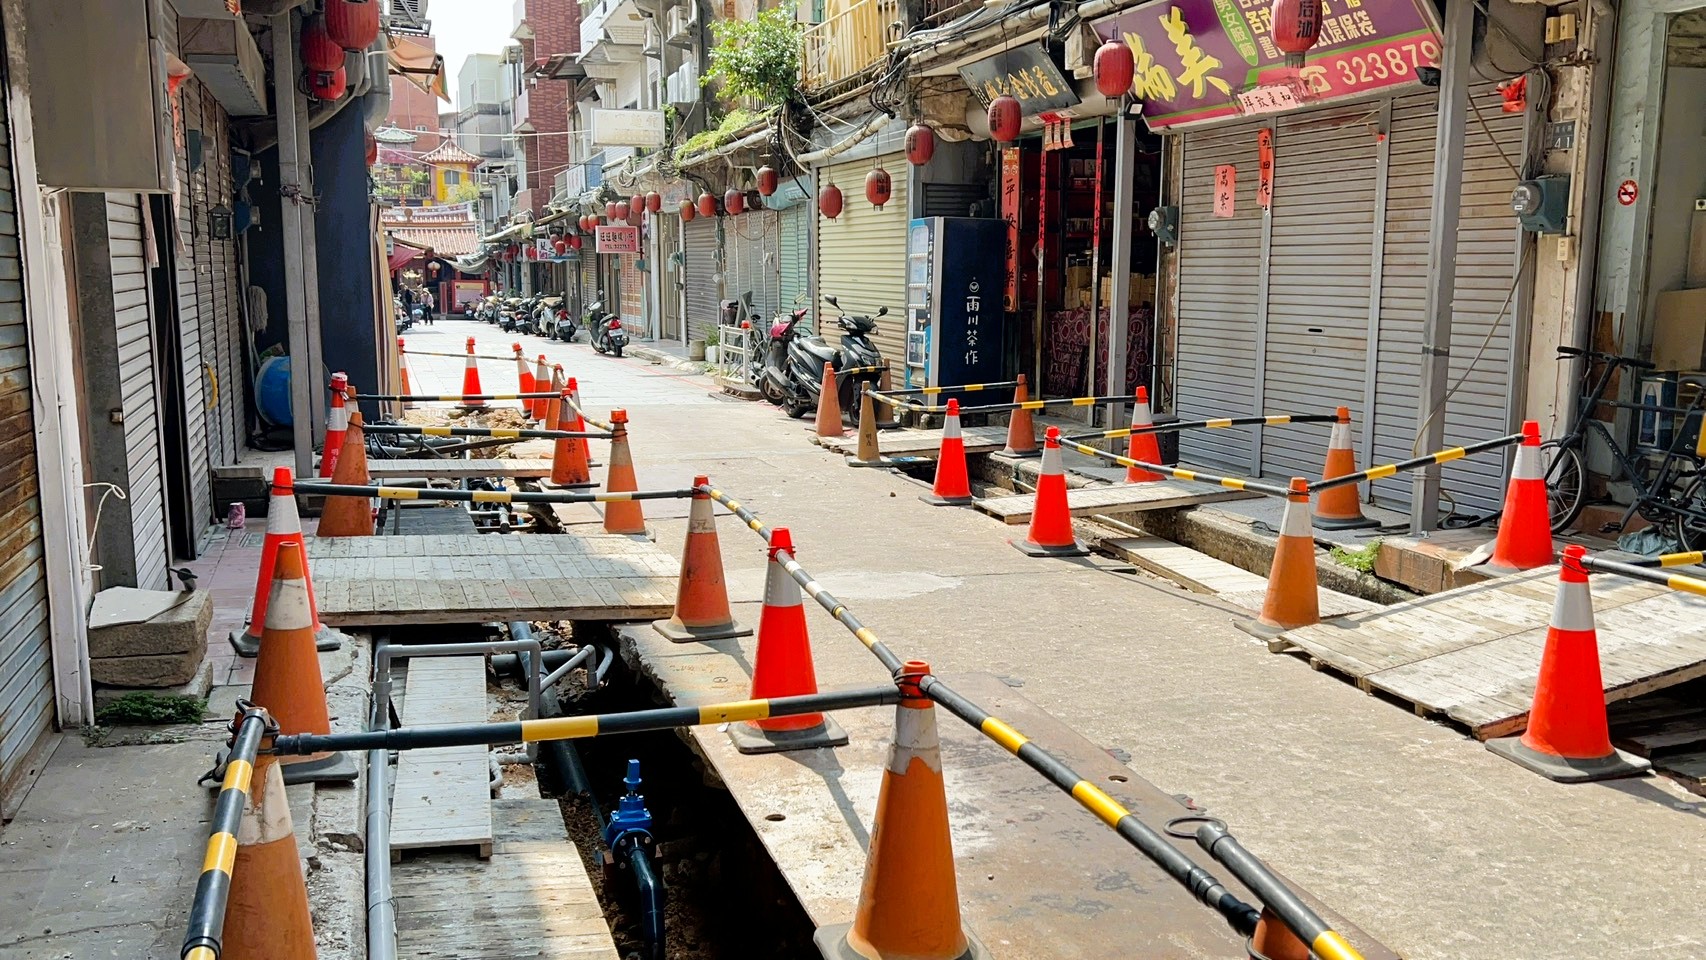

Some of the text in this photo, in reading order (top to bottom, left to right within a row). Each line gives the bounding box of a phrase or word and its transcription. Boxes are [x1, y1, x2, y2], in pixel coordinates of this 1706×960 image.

[1337, 41, 1440, 85] 323879
[1554, 136, 1570, 148] 41
[965, 295, 981, 365] 雨川茶作
